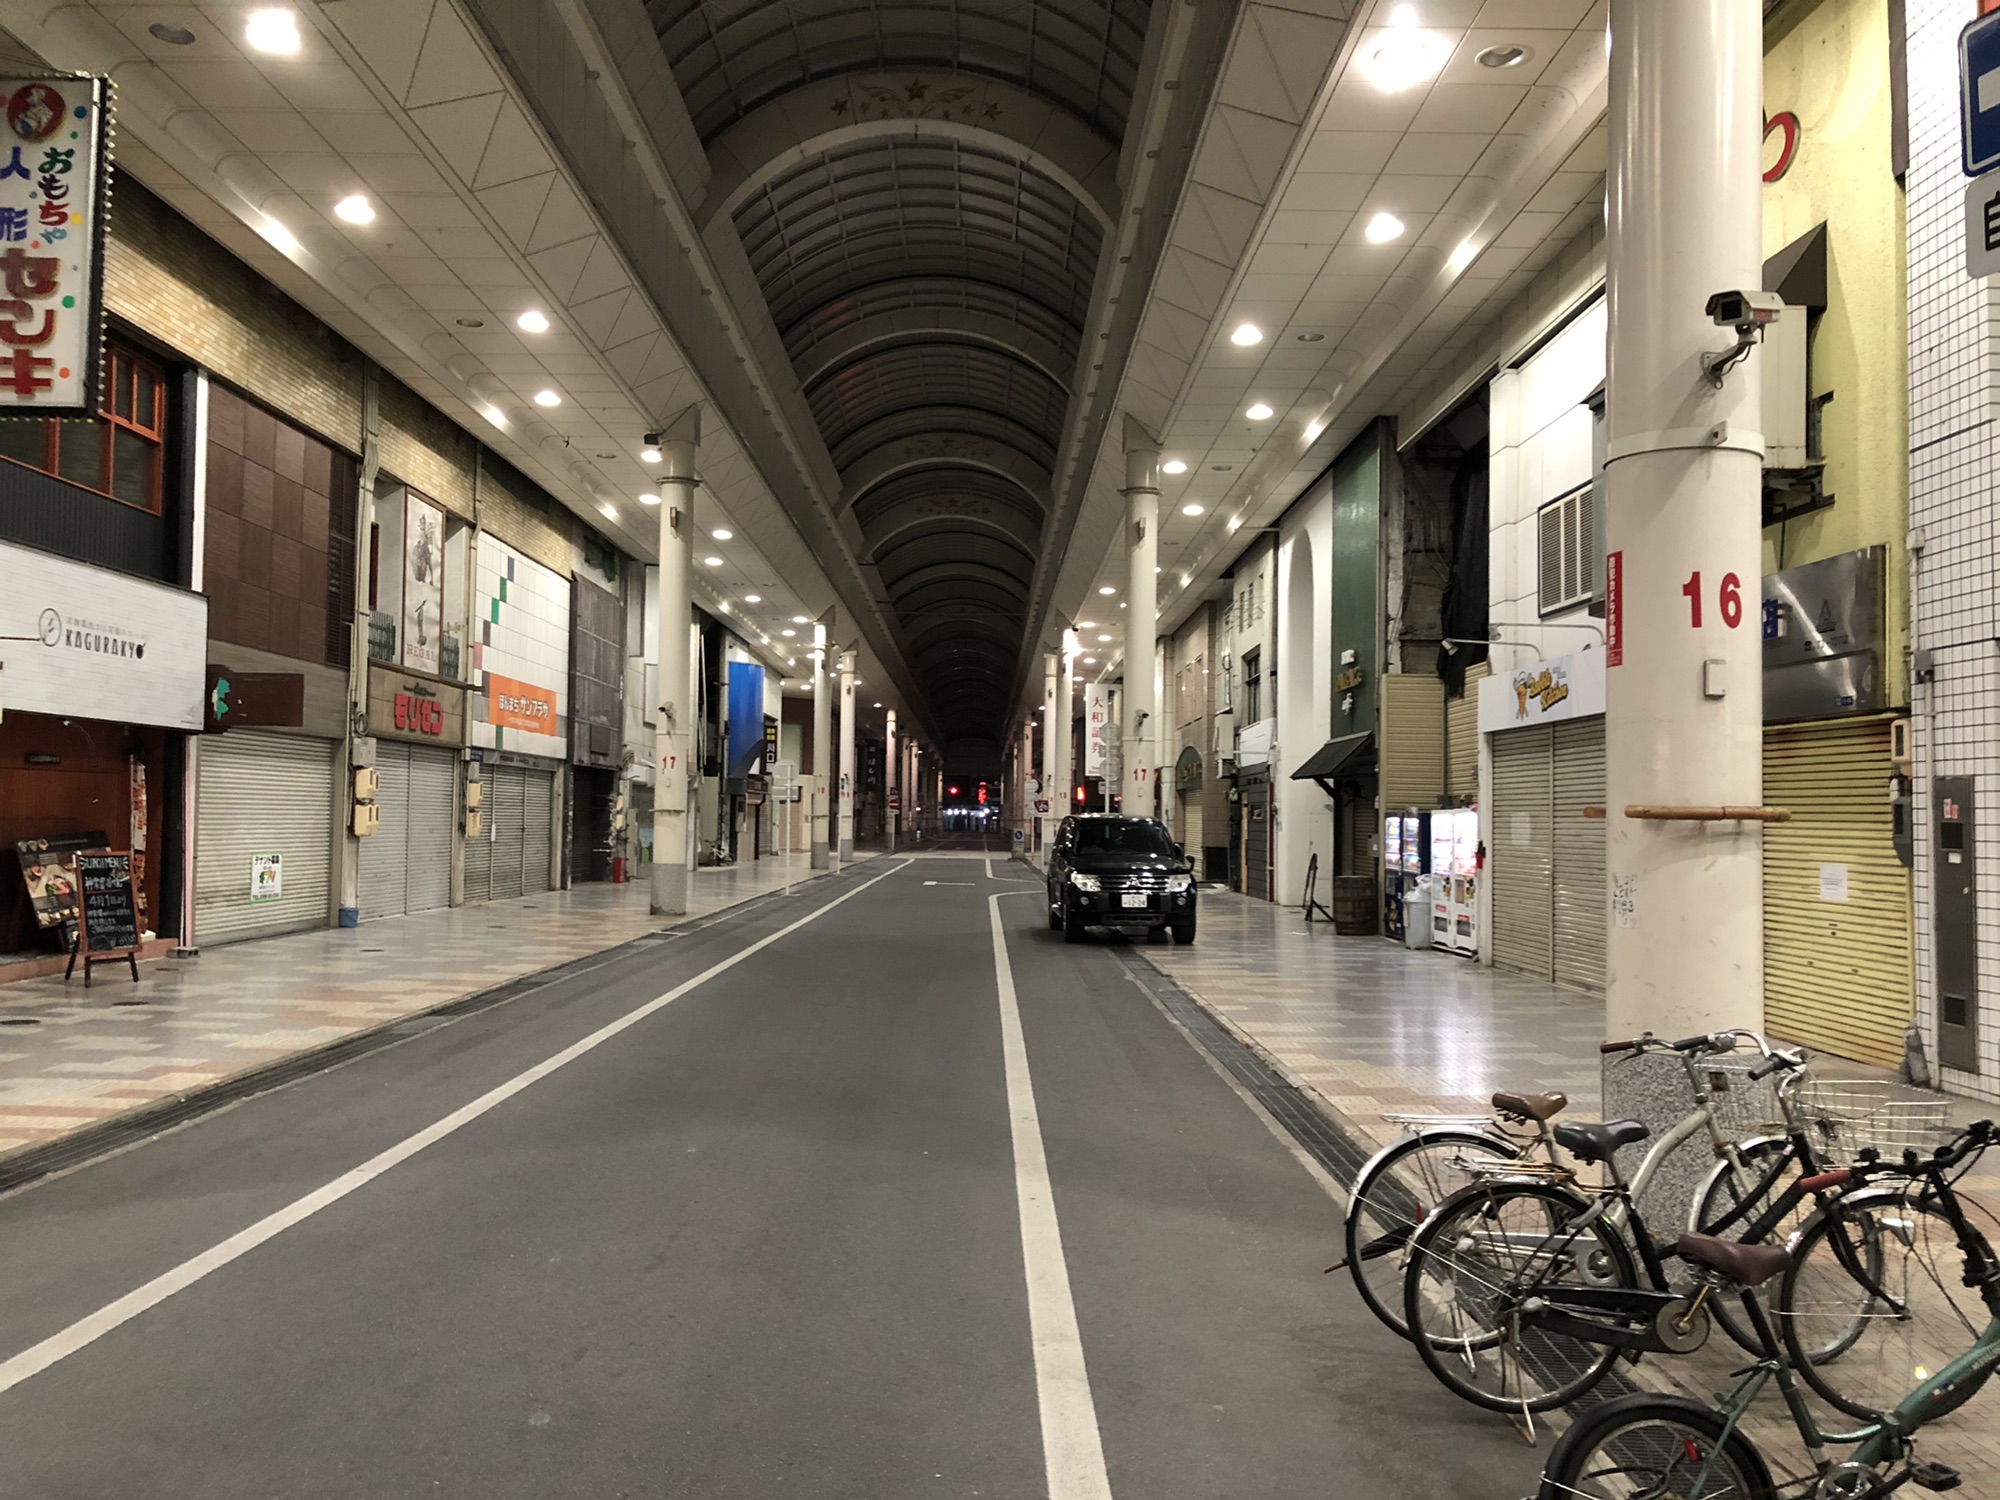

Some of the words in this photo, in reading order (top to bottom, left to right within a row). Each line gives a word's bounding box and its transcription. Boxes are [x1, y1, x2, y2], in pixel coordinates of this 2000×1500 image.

[38, 148, 75, 245] おもちゃ
[1683, 571, 1742, 629] 16
[406, 643, 437, 661] REGAL
[662, 756, 676, 769] 17
[1133, 768, 1147, 781] 17
[105, 856, 123, 868] MENU
